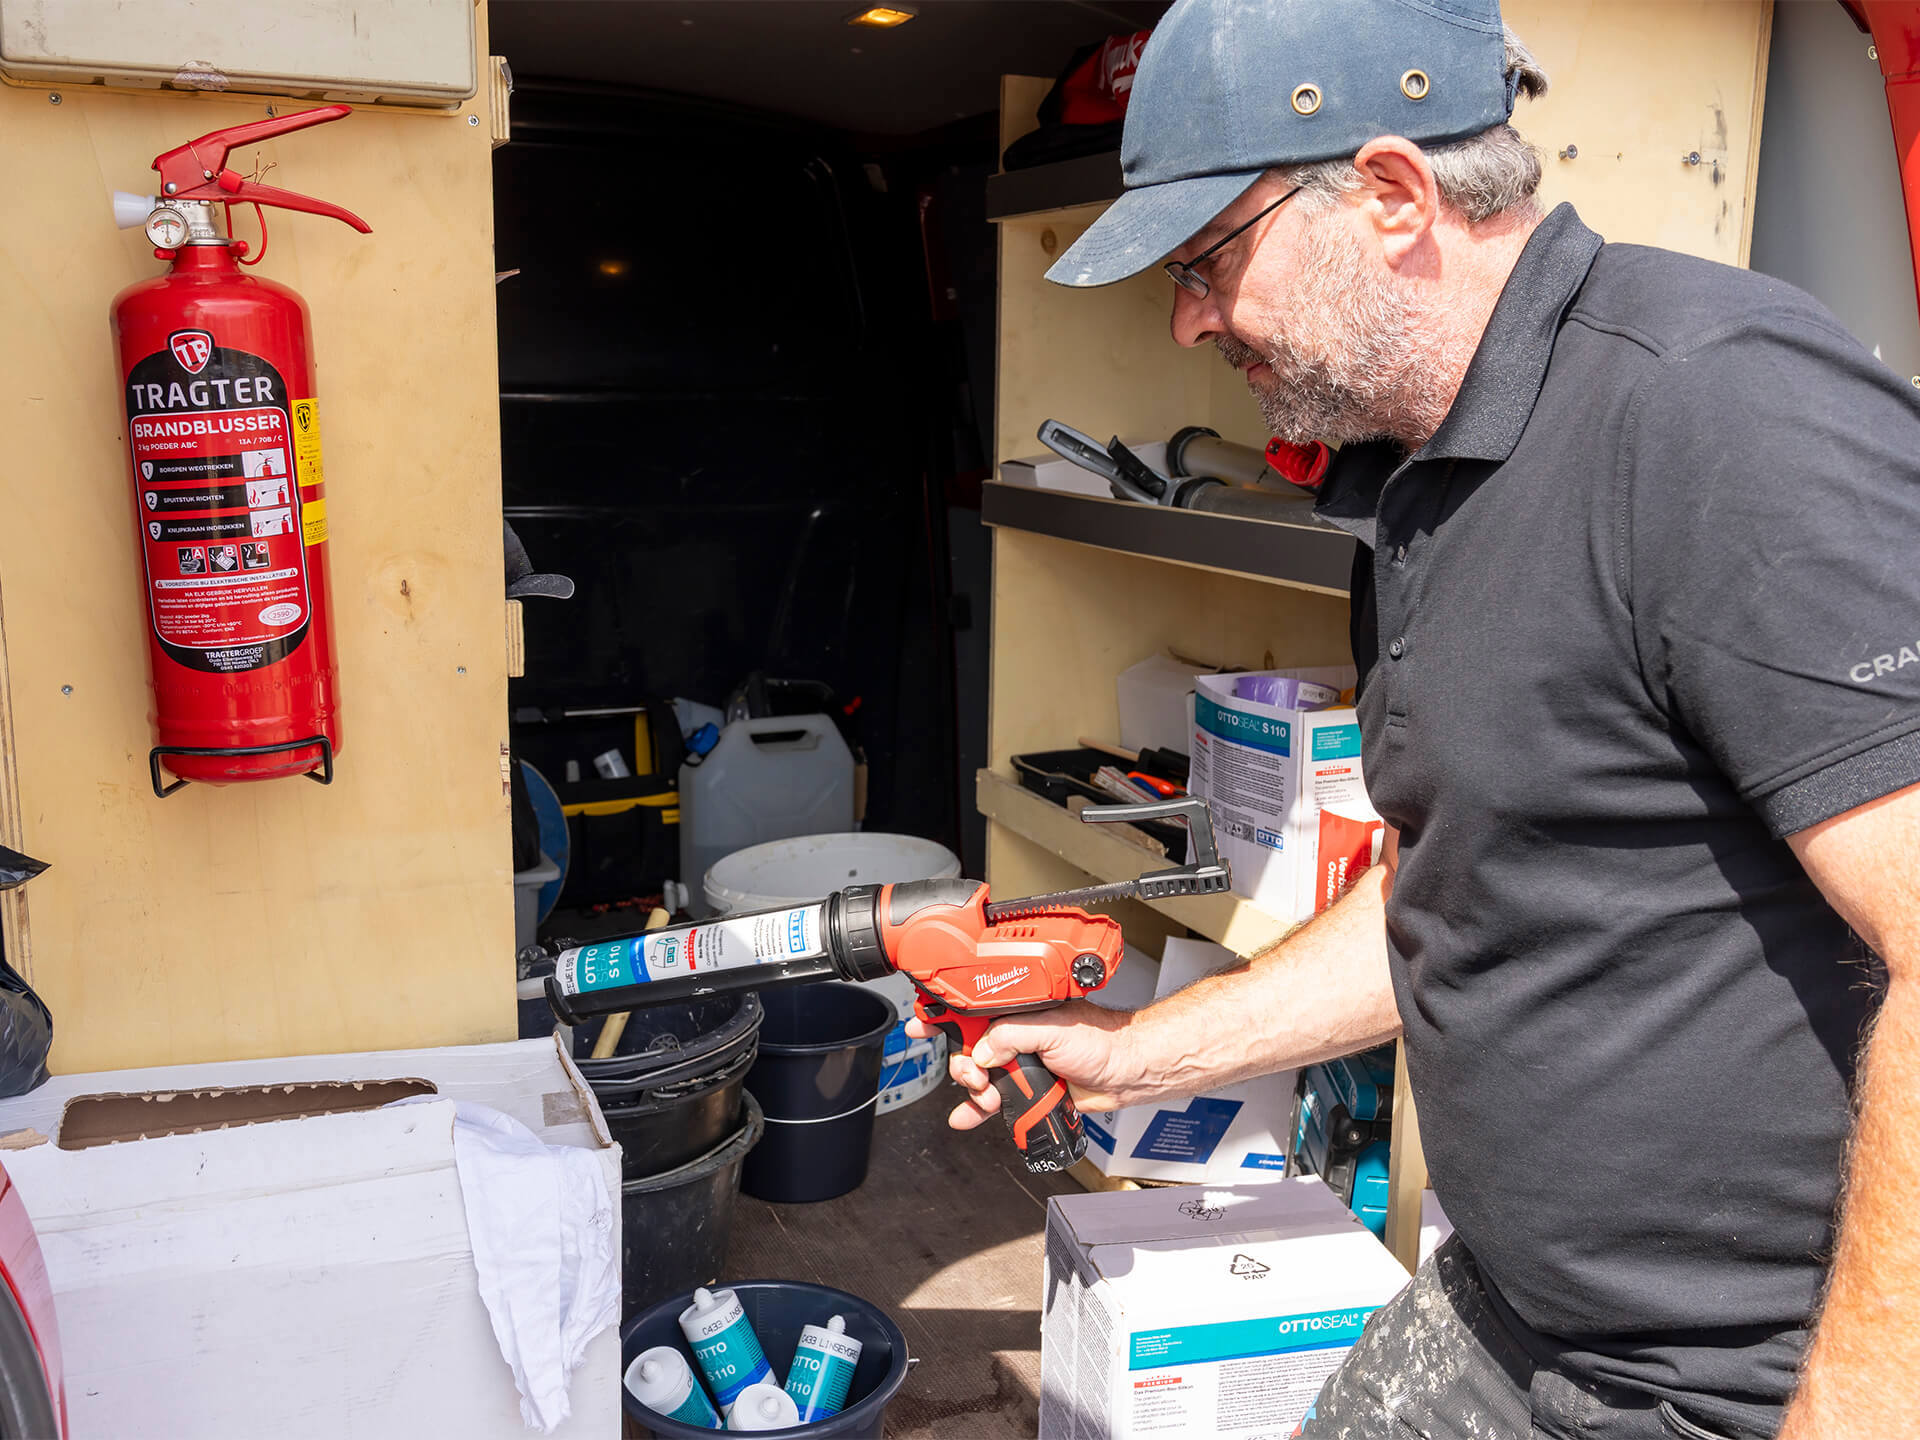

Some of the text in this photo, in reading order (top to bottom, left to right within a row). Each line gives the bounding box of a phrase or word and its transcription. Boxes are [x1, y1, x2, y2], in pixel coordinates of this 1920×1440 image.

[132, 376, 274, 409] TRAGTER
[134, 415, 280, 438] BRANDBLUSSER
[150, 443, 179, 451] POEDER
[145, 465, 150, 475] 1
[188, 464, 234, 472] WEGTREKKEN
[148, 496, 155, 505] 2
[152, 526, 158, 535] 3
[206, 523, 245, 531] INDRUKKEN
[194, 543, 266, 558] A B C
[210, 577, 249, 585] ELEKTRISCHE
[206, 589, 233, 597] GEBRUIK
[234, 586, 269, 594] HERVULLEN
[205, 646, 264, 659] TRAGTERGROEP
[1262, 722, 1269, 734] S
[1271, 725, 1286, 738] 110
[585, 948, 598, 984] OTTO
[609, 945, 621, 978] S 110
[972, 965, 1030, 992] Milwaukee
[1243, 1273, 1266, 1281] PAP
[702, 1319, 723, 1336] C433
[696, 1341, 727, 1360] OTTO
[792, 1355, 820, 1371] OTTO
[706, 1364, 736, 1382] S 110
[792, 1381, 811, 1396] 110
